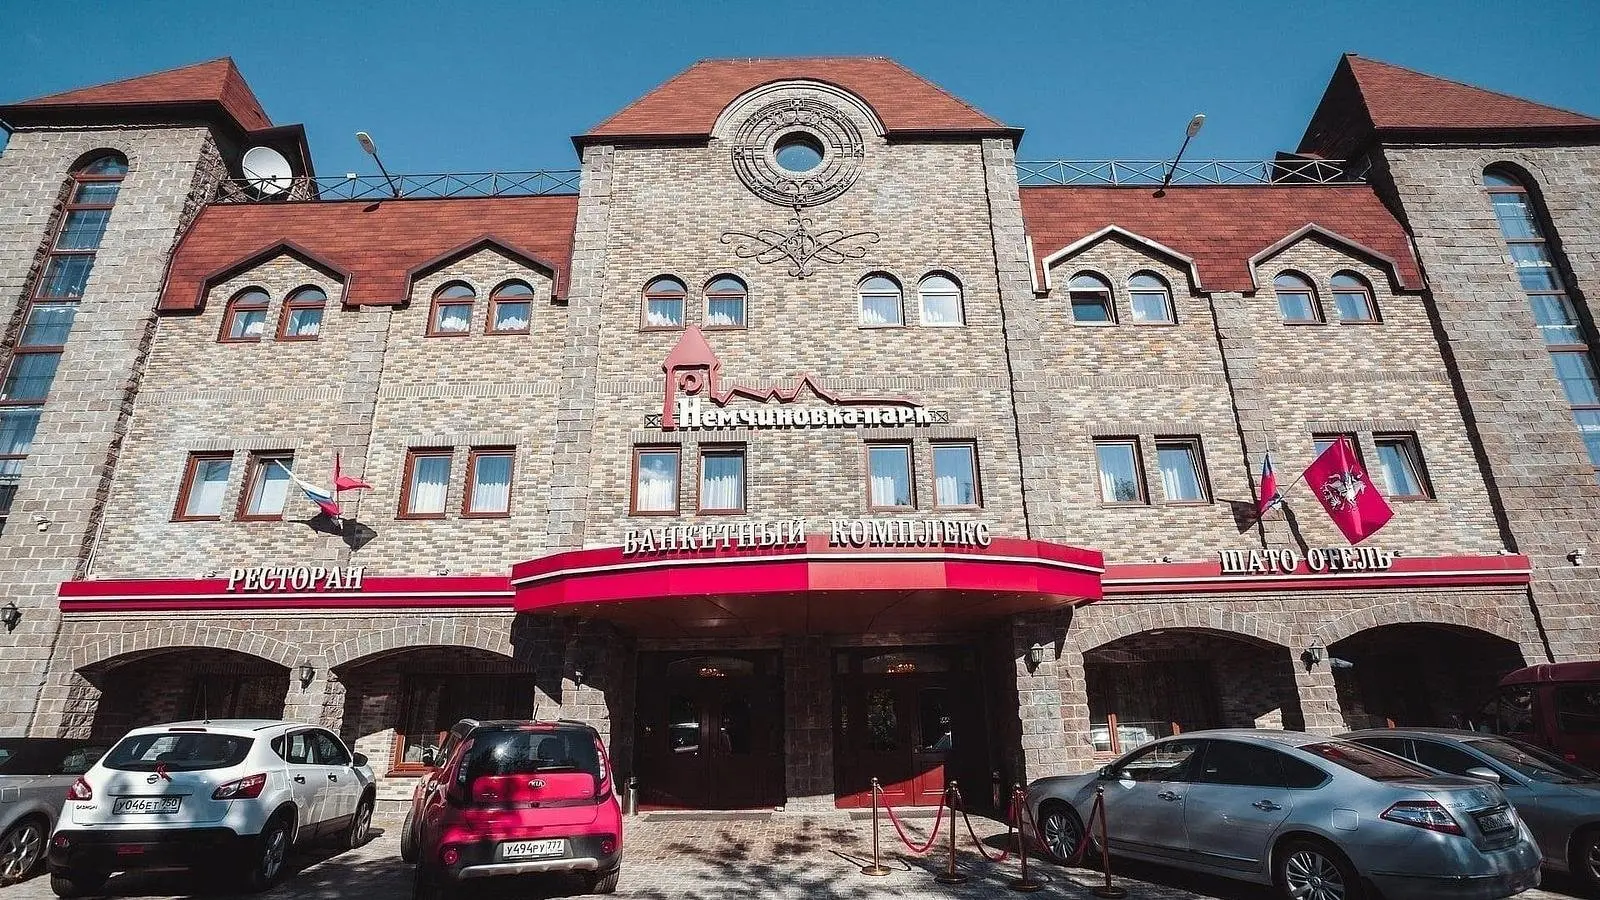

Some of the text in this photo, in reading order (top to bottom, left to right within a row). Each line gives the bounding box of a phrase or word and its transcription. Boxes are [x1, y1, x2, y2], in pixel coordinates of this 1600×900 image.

[622, 517, 992, 555] БАНКЕТНЫЙ КОМПЛЕКС
[1219, 547, 1393, 574] ШАТО ОТЕЛЬ
[226, 566, 366, 592] РЕСТОРАН
